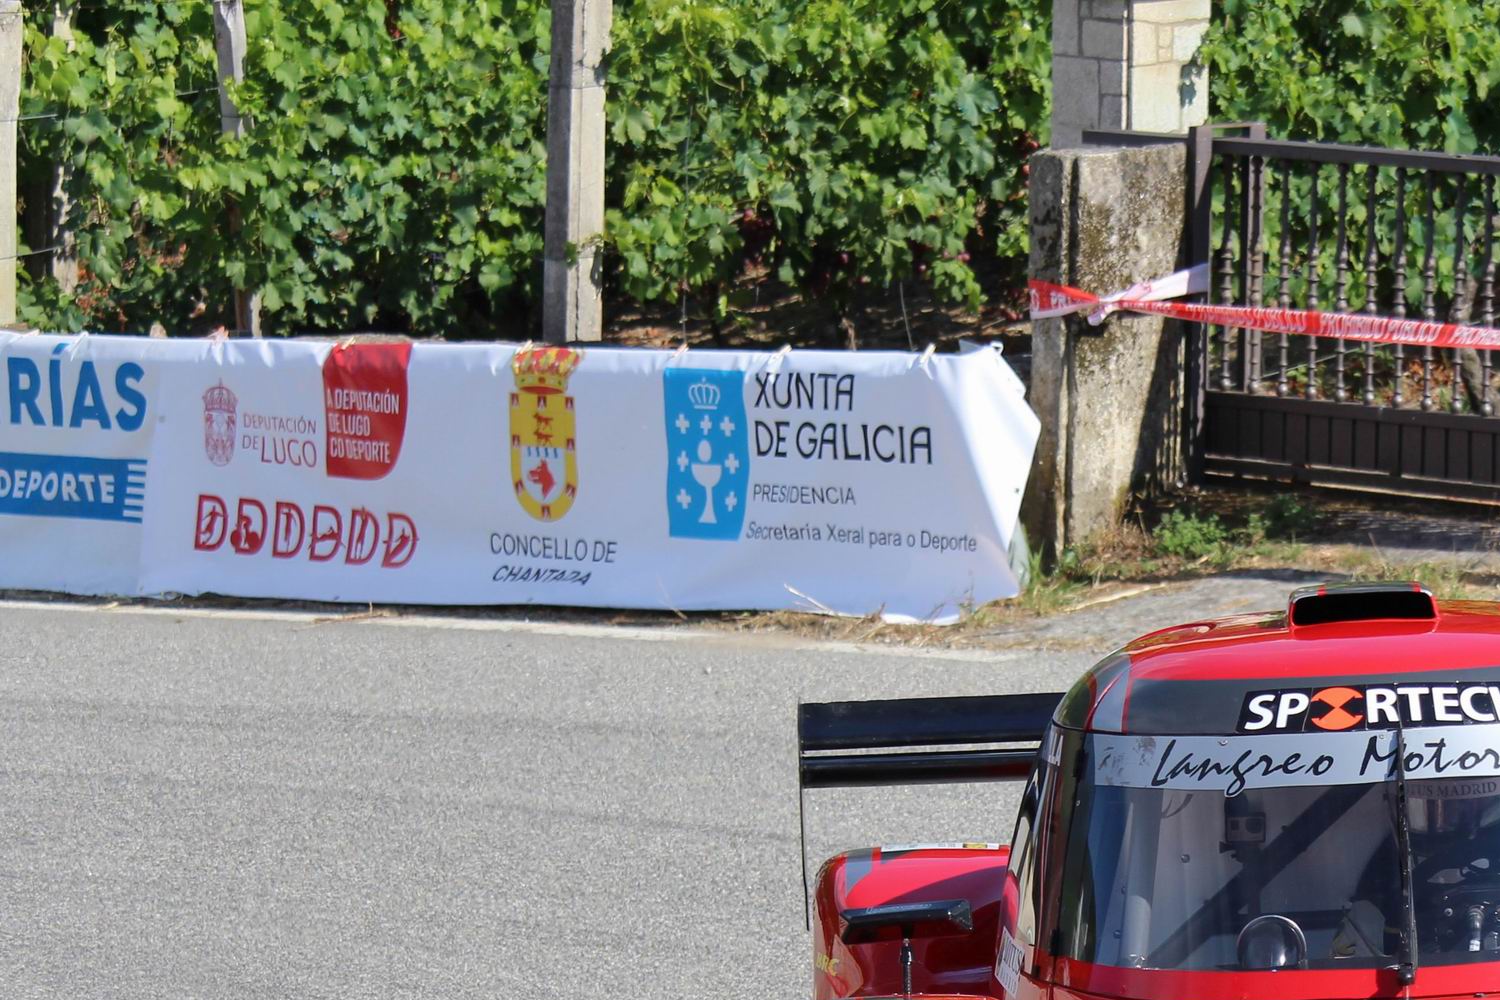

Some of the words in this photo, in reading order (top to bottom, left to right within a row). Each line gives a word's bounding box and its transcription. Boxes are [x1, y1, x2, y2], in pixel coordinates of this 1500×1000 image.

[7, 343, 147, 432] RÍAS
[334, 388, 400, 415] DEPUTACIÓN
[754, 371, 856, 412] XUNTA
[242, 412, 318, 436] DEPUTACIÓN
[327, 412, 343, 434] DE
[342, 415, 372, 437] LUGO
[241, 434, 260, 450] DE
[260, 436, 318, 469] LUGO
[348, 441, 392, 464] DEPORTE
[754, 420, 791, 459] DE
[796, 421, 933, 465] GALICIA
[0, 468, 116, 504] DEPORTE
[752, 483, 858, 506] PRESIDENCIA
[490, 532, 588, 561] CONCELLO
[591, 540, 618, 564] DE
[745, 520, 822, 542] Secretaria
[826, 523, 865, 545] Xeral
[869, 530, 902, 550] para
[906, 532, 917, 548] o
[920, 530, 978, 553] Deporte
[1150, 738, 1335, 799] Langreo
[1436, 781, 1497, 797] MADRID
